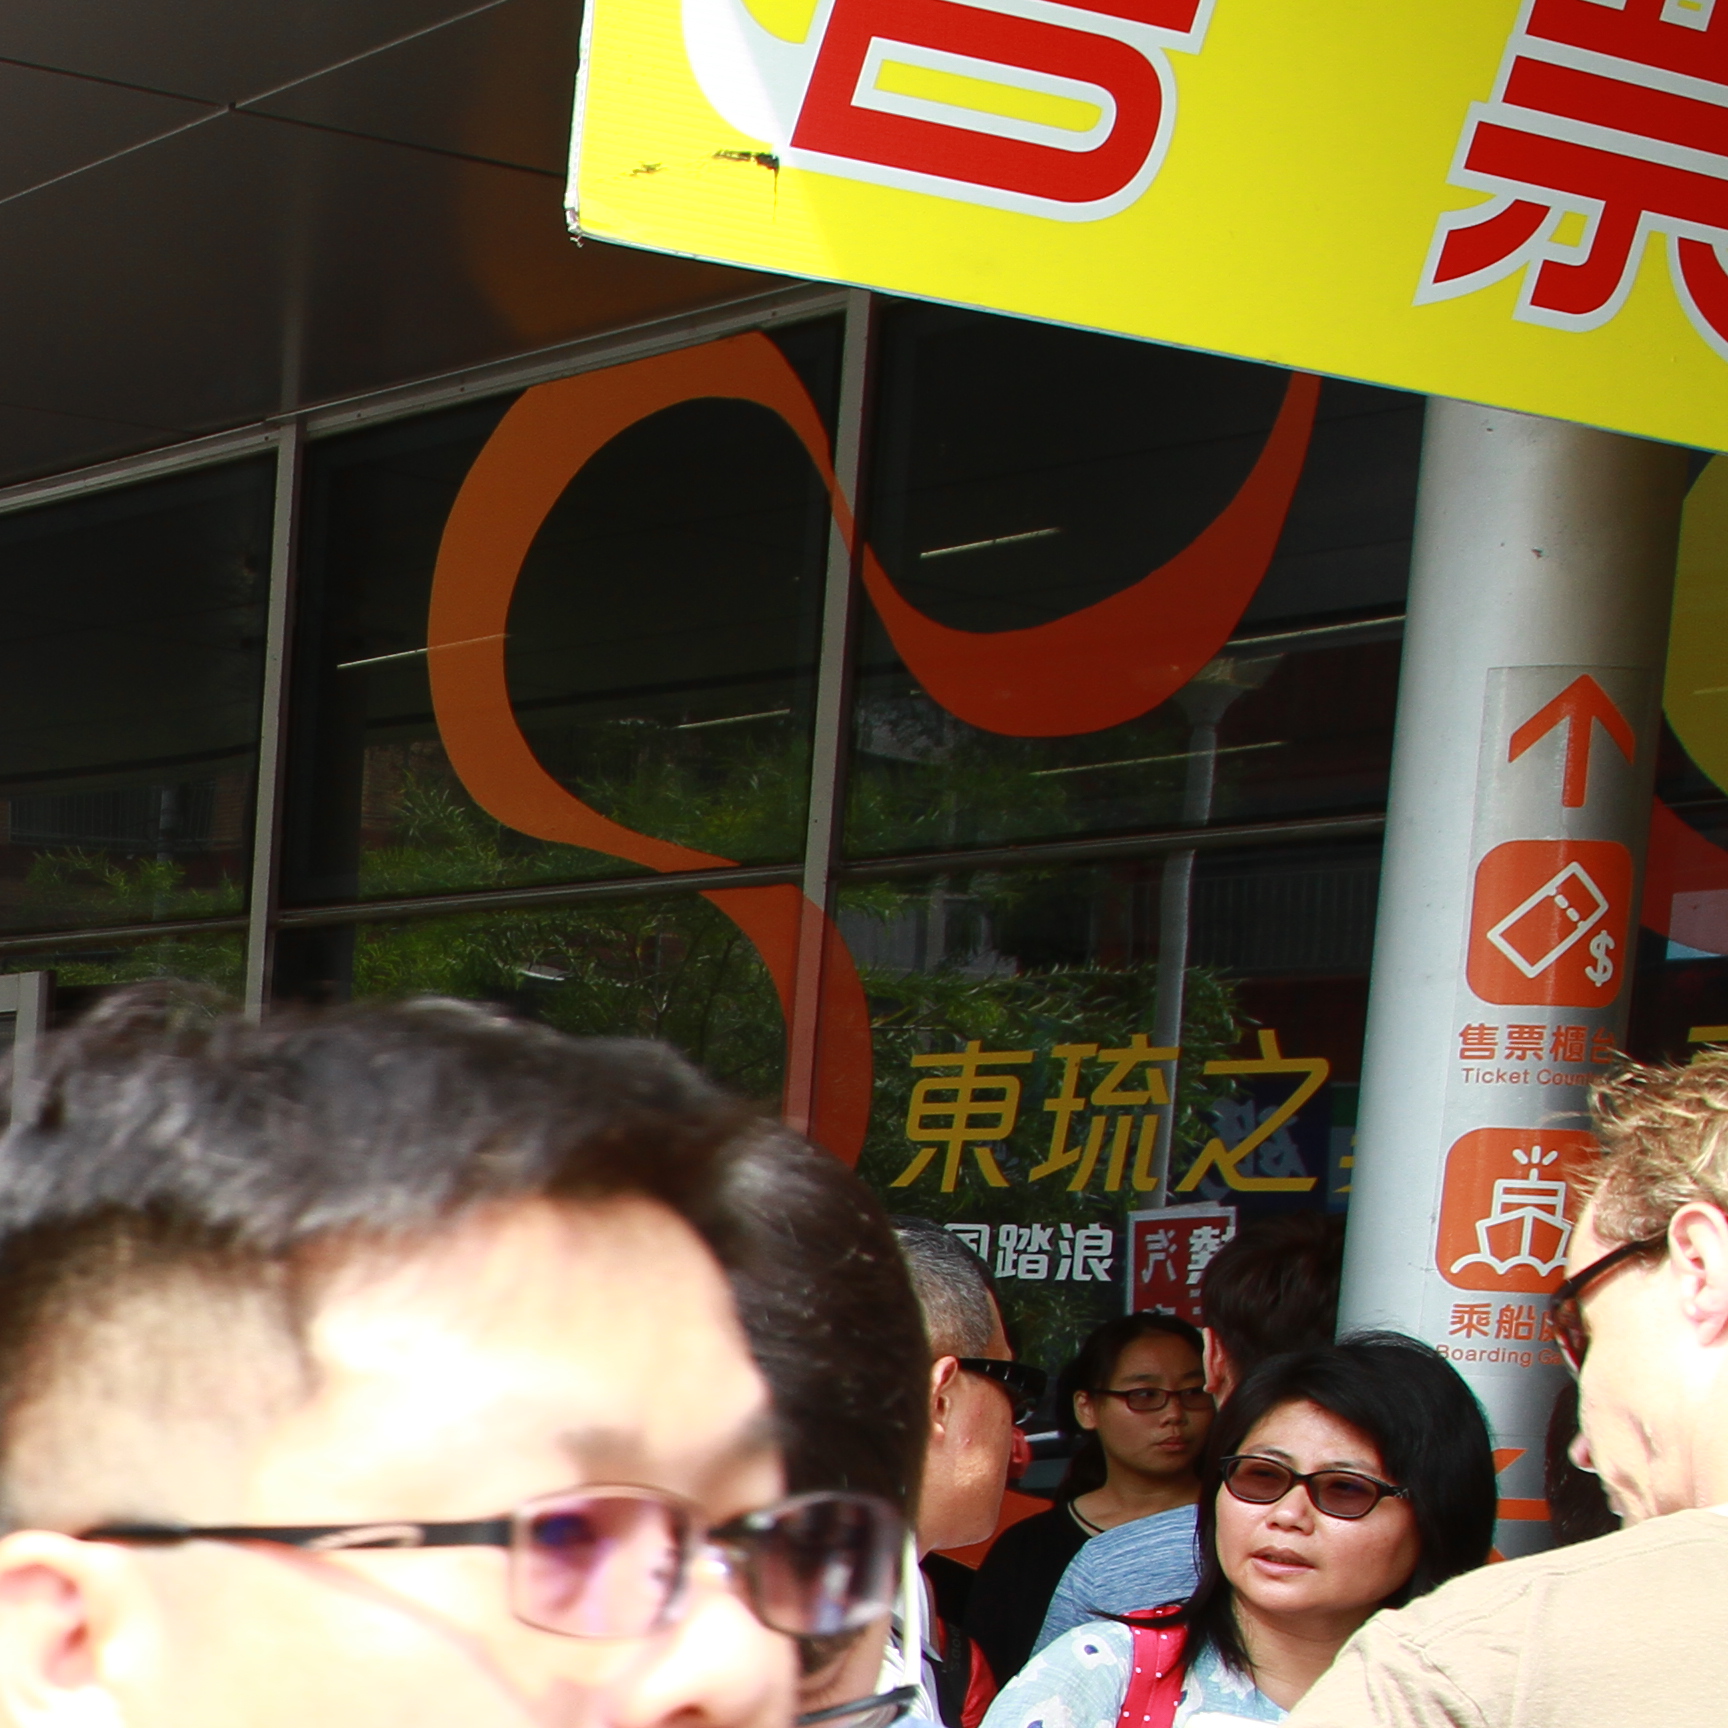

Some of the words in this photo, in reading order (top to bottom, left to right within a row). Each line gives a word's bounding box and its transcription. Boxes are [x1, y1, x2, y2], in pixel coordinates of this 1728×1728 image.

[1458, 1023, 1616, 1065] 售票櫃台
[1462, 1067, 1530, 1084] Ticket
[889, 1028, 1356, 1194] 東琉之
[1435, 1344, 1532, 1367] Boarding
